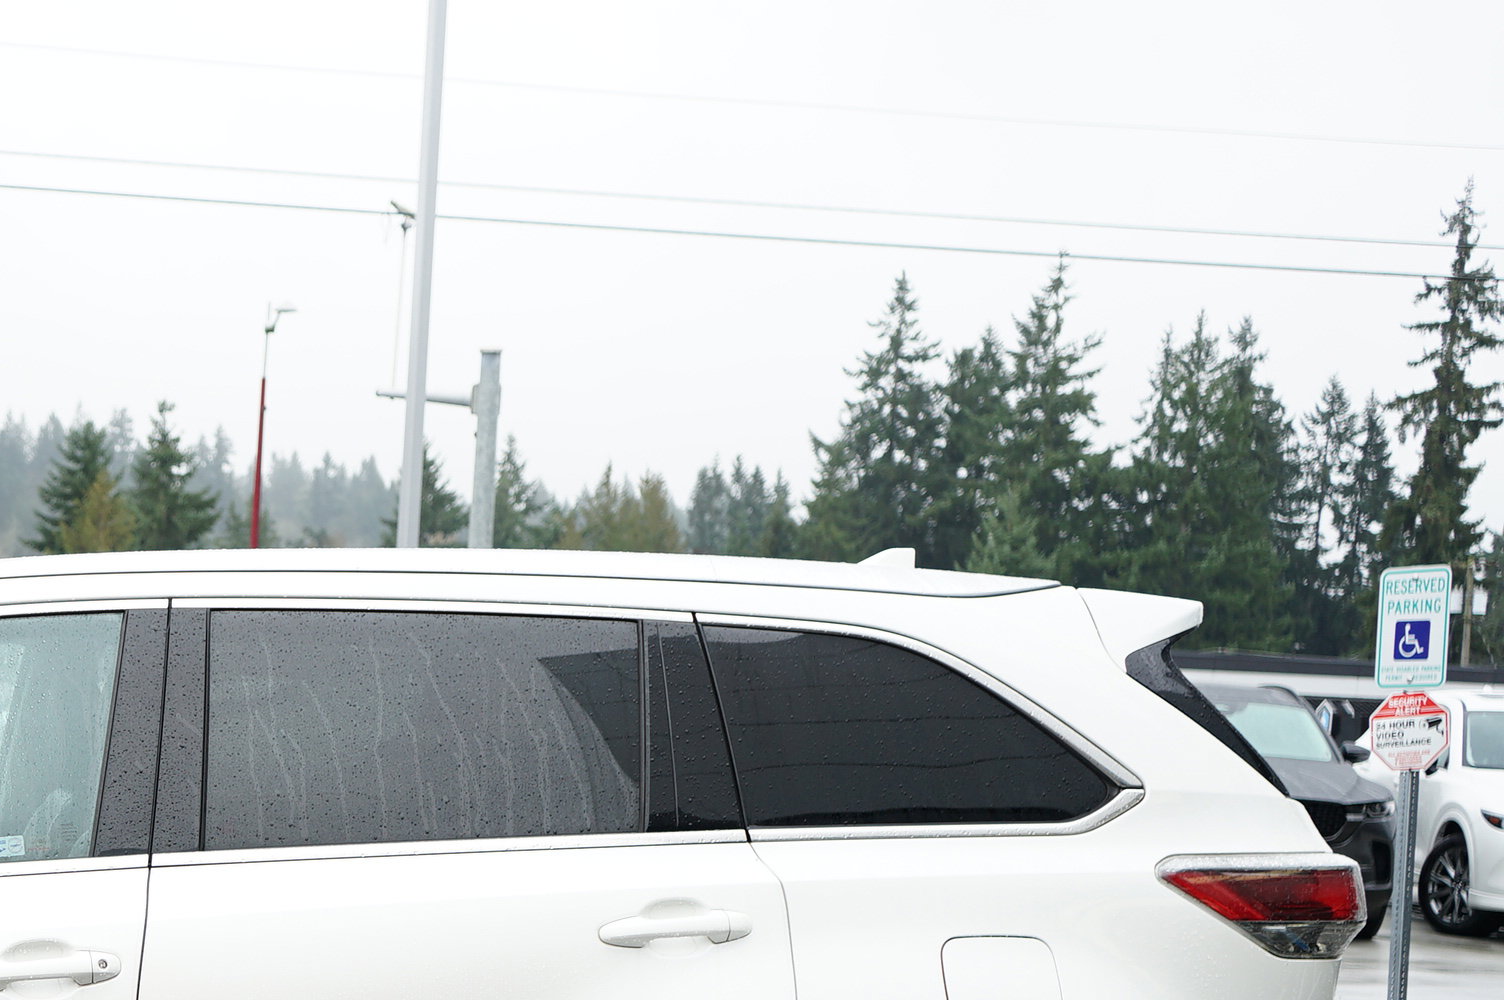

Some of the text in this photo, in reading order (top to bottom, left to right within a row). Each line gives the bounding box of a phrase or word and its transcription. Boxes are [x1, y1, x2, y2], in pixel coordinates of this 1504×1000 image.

[1386, 577, 1445, 595] RESERVED
[1388, 598, 1441, 616] PARKING
[1388, 695, 1427, 708] SECURITY
[1395, 706, 1421, 716] ALERT
[1389, 720, 1415, 730] HOUR
[1376, 731, 1405, 740] VIDEO
[1376, 738, 1432, 749] SURVEILLANCE
